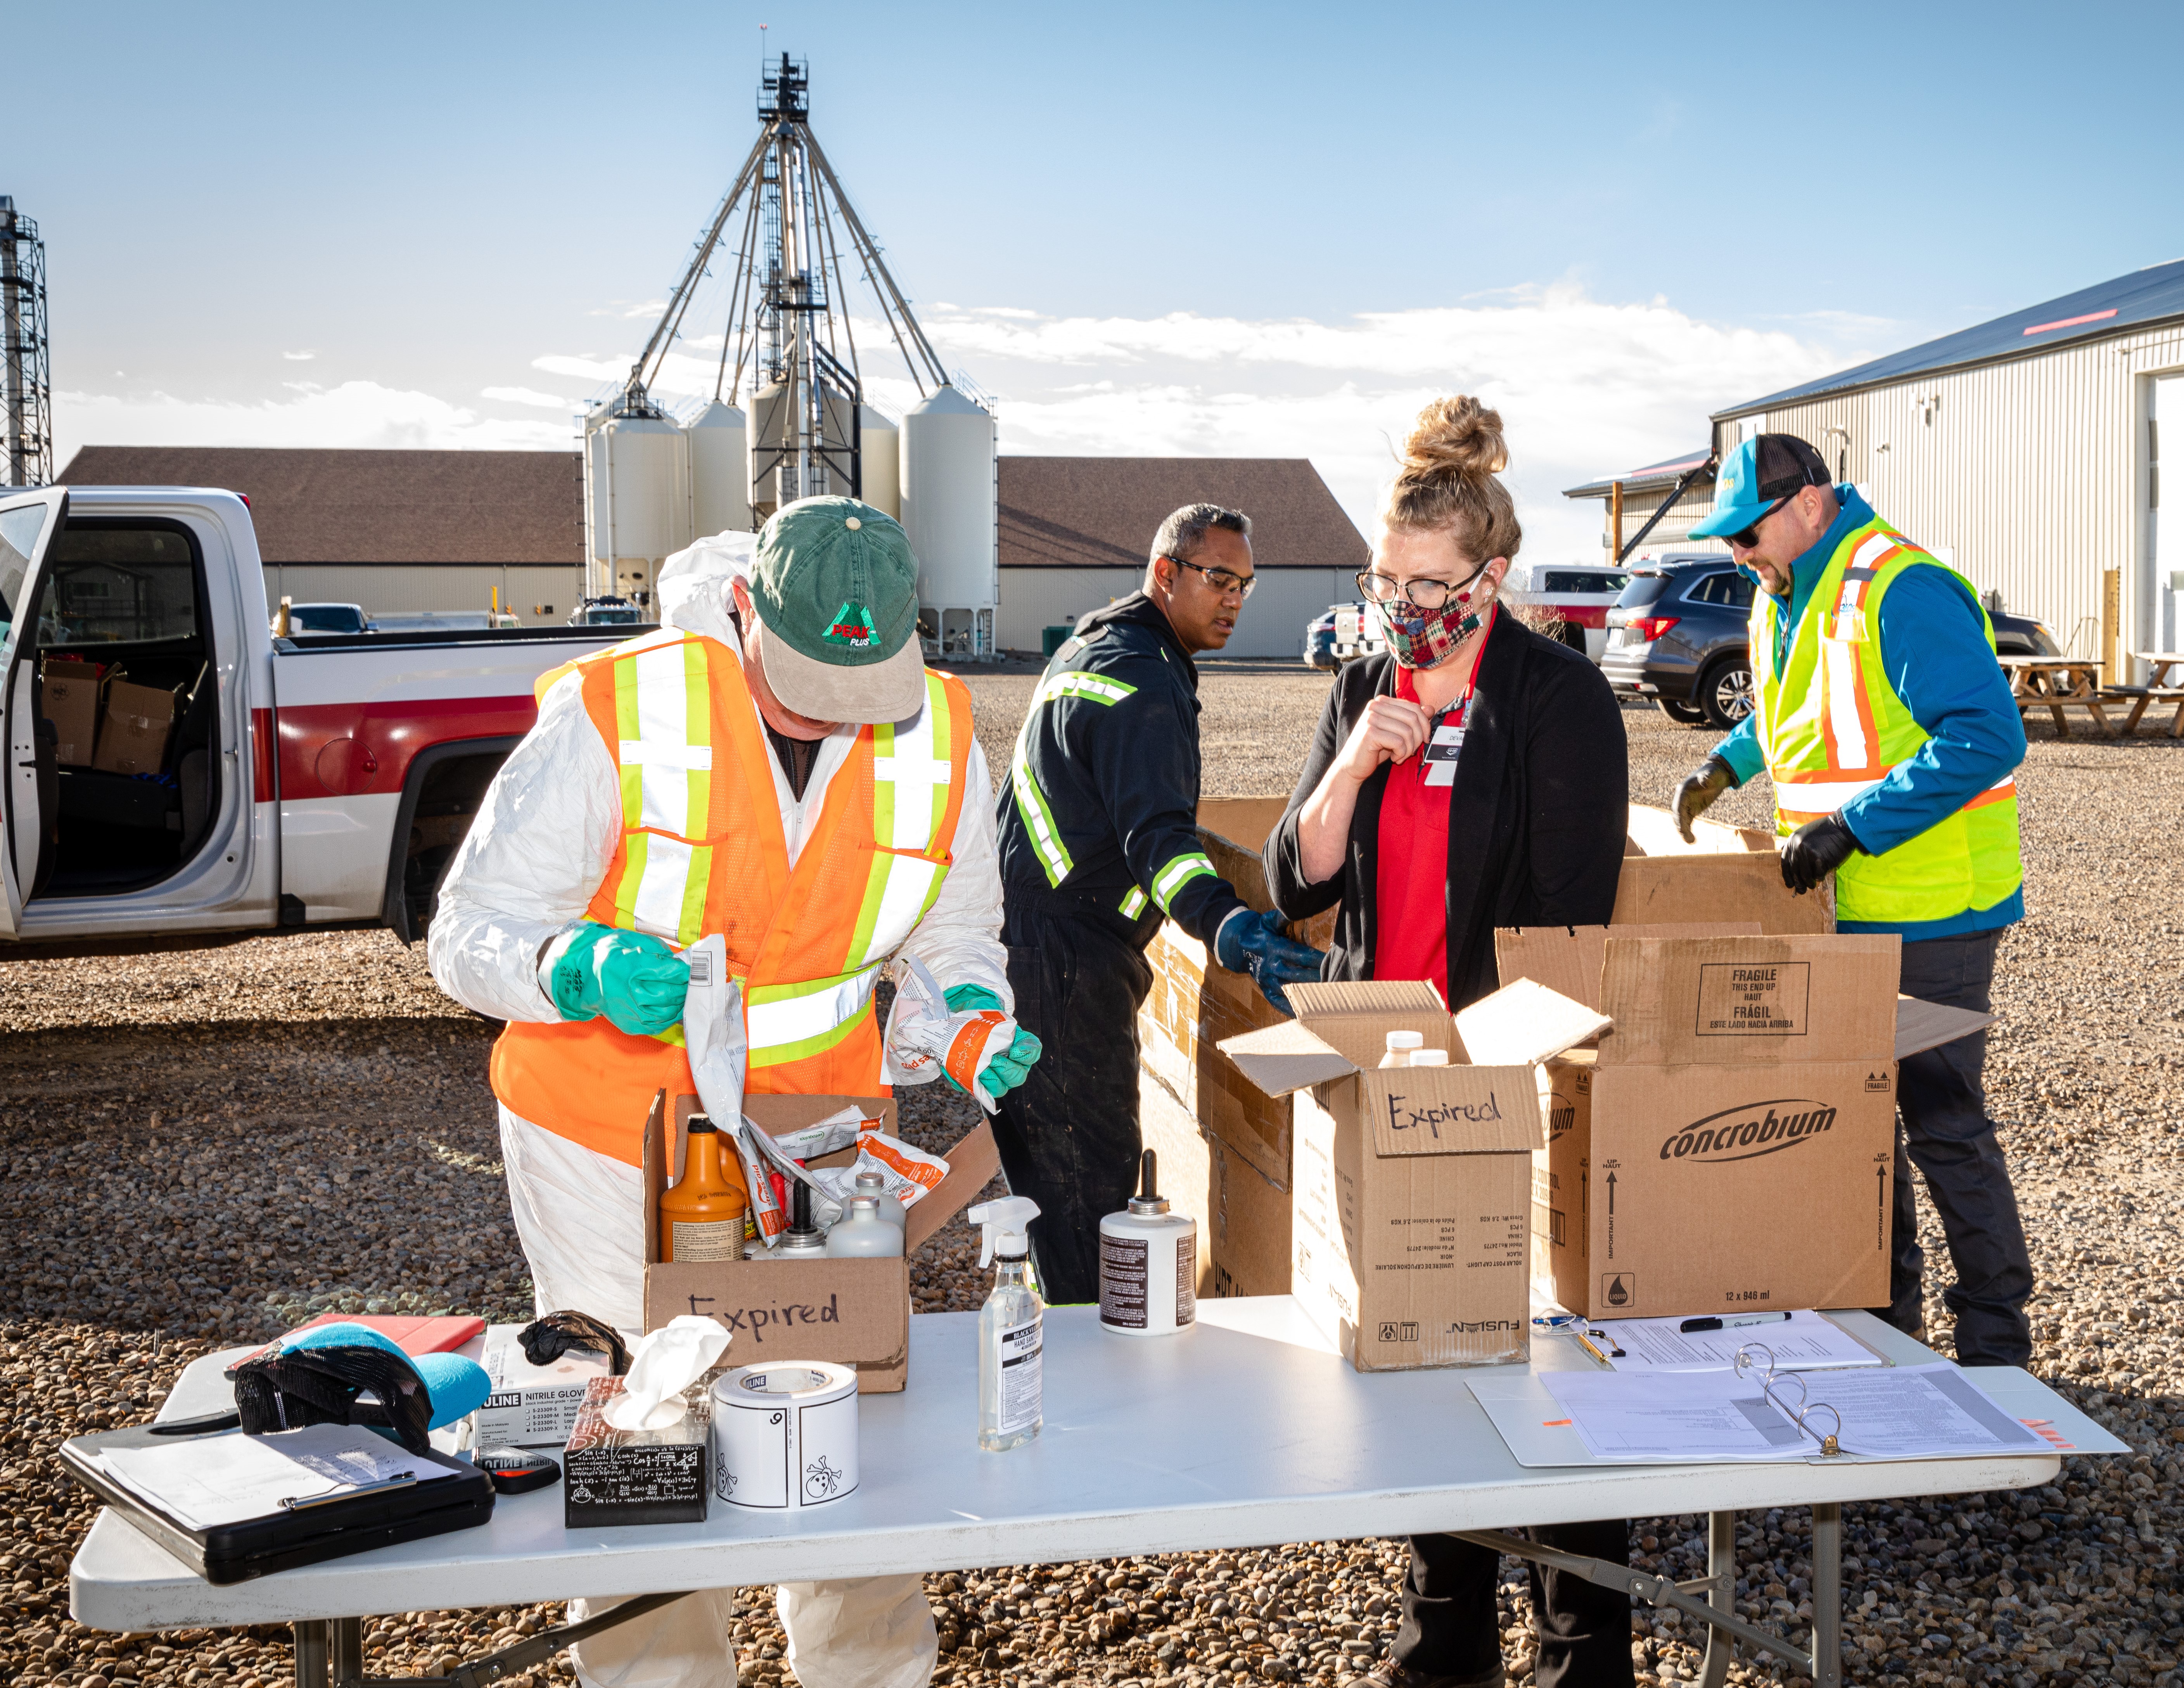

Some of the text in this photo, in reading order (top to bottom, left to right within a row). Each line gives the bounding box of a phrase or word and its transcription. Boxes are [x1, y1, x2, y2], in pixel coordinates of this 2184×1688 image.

[832, 624, 870, 638] PEAK
[850, 638, 870, 646] PLUS
[1733, 969, 1777, 981] FRAGILE
[1750, 983, 1764, 991] END
[1734, 1004, 1771, 1018] FRÁGIL
[1769, 1020, 1793, 1028] ARRIBA
[1389, 1092, 1501, 1138] Expired
[1541, 1101, 1575, 1131] bium
[799, 1133, 823, 1141] vetoquinol
[1538, 1169, 1560, 1189] CONTROL
[752, 1165, 771, 1206] stress-aid
[1725, 1292, 1734, 1301] 12
[1743, 1291, 1757, 1300] 946
[1760, 1290, 1770, 1300] ml
[688, 1293, 840, 1343] Expired
[1014, 1329, 1029, 1339] BLACK
[1014, 1338, 1025, 1348] HAND
[746, 1377, 765, 1388] ULINE
[484, 1394, 519, 1407] ULINE
[526, 1392, 555, 1401] NITRILE
